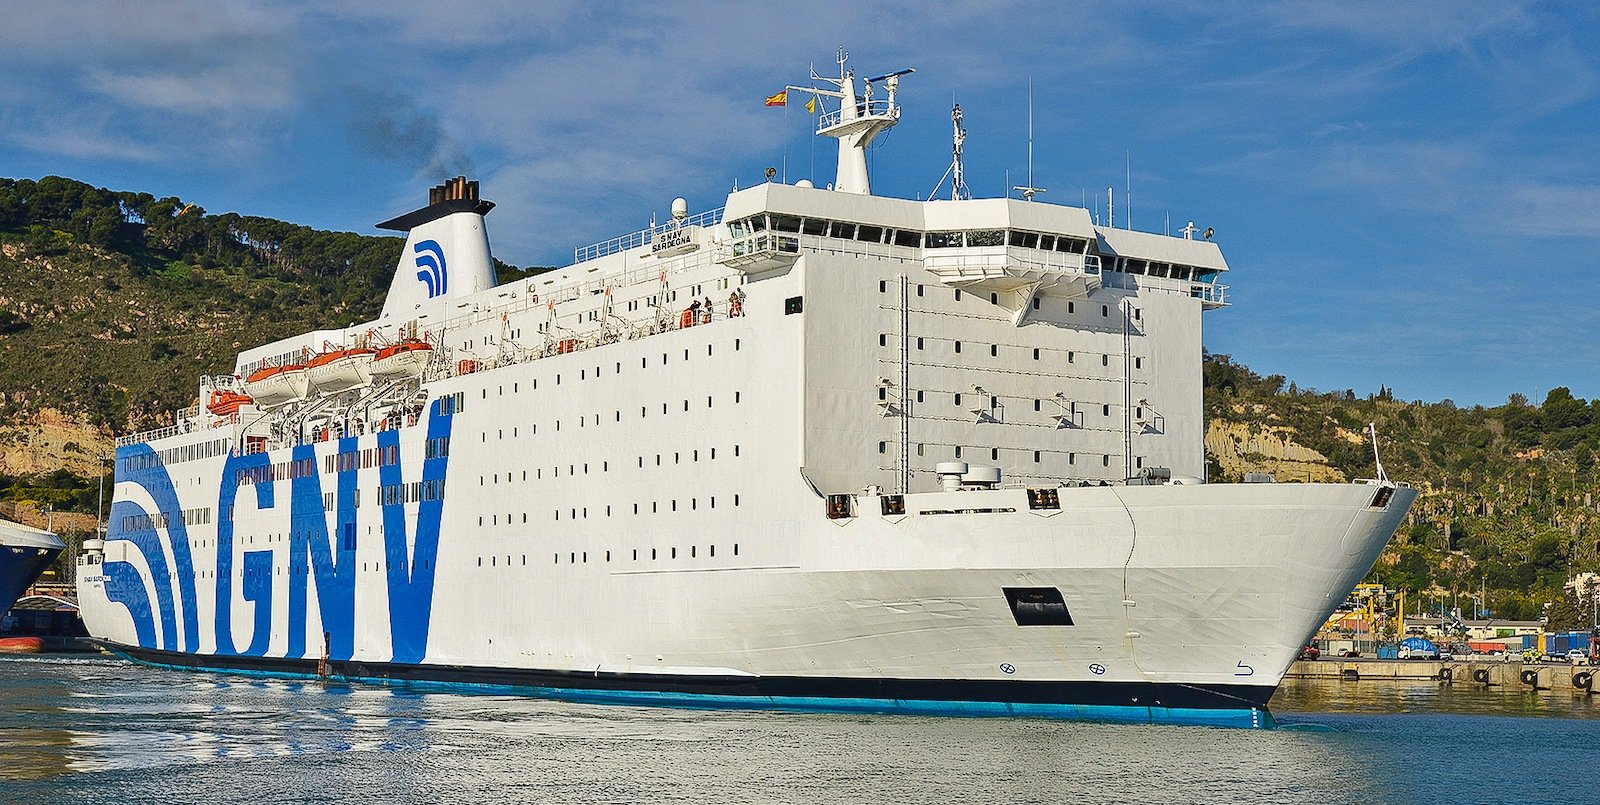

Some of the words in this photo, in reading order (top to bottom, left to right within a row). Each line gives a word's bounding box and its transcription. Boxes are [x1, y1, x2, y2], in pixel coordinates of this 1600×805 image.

[652, 235, 691, 252] SARDEGNA
[661, 230, 682, 242] SNAV
[215, 398, 454, 664] GNV
